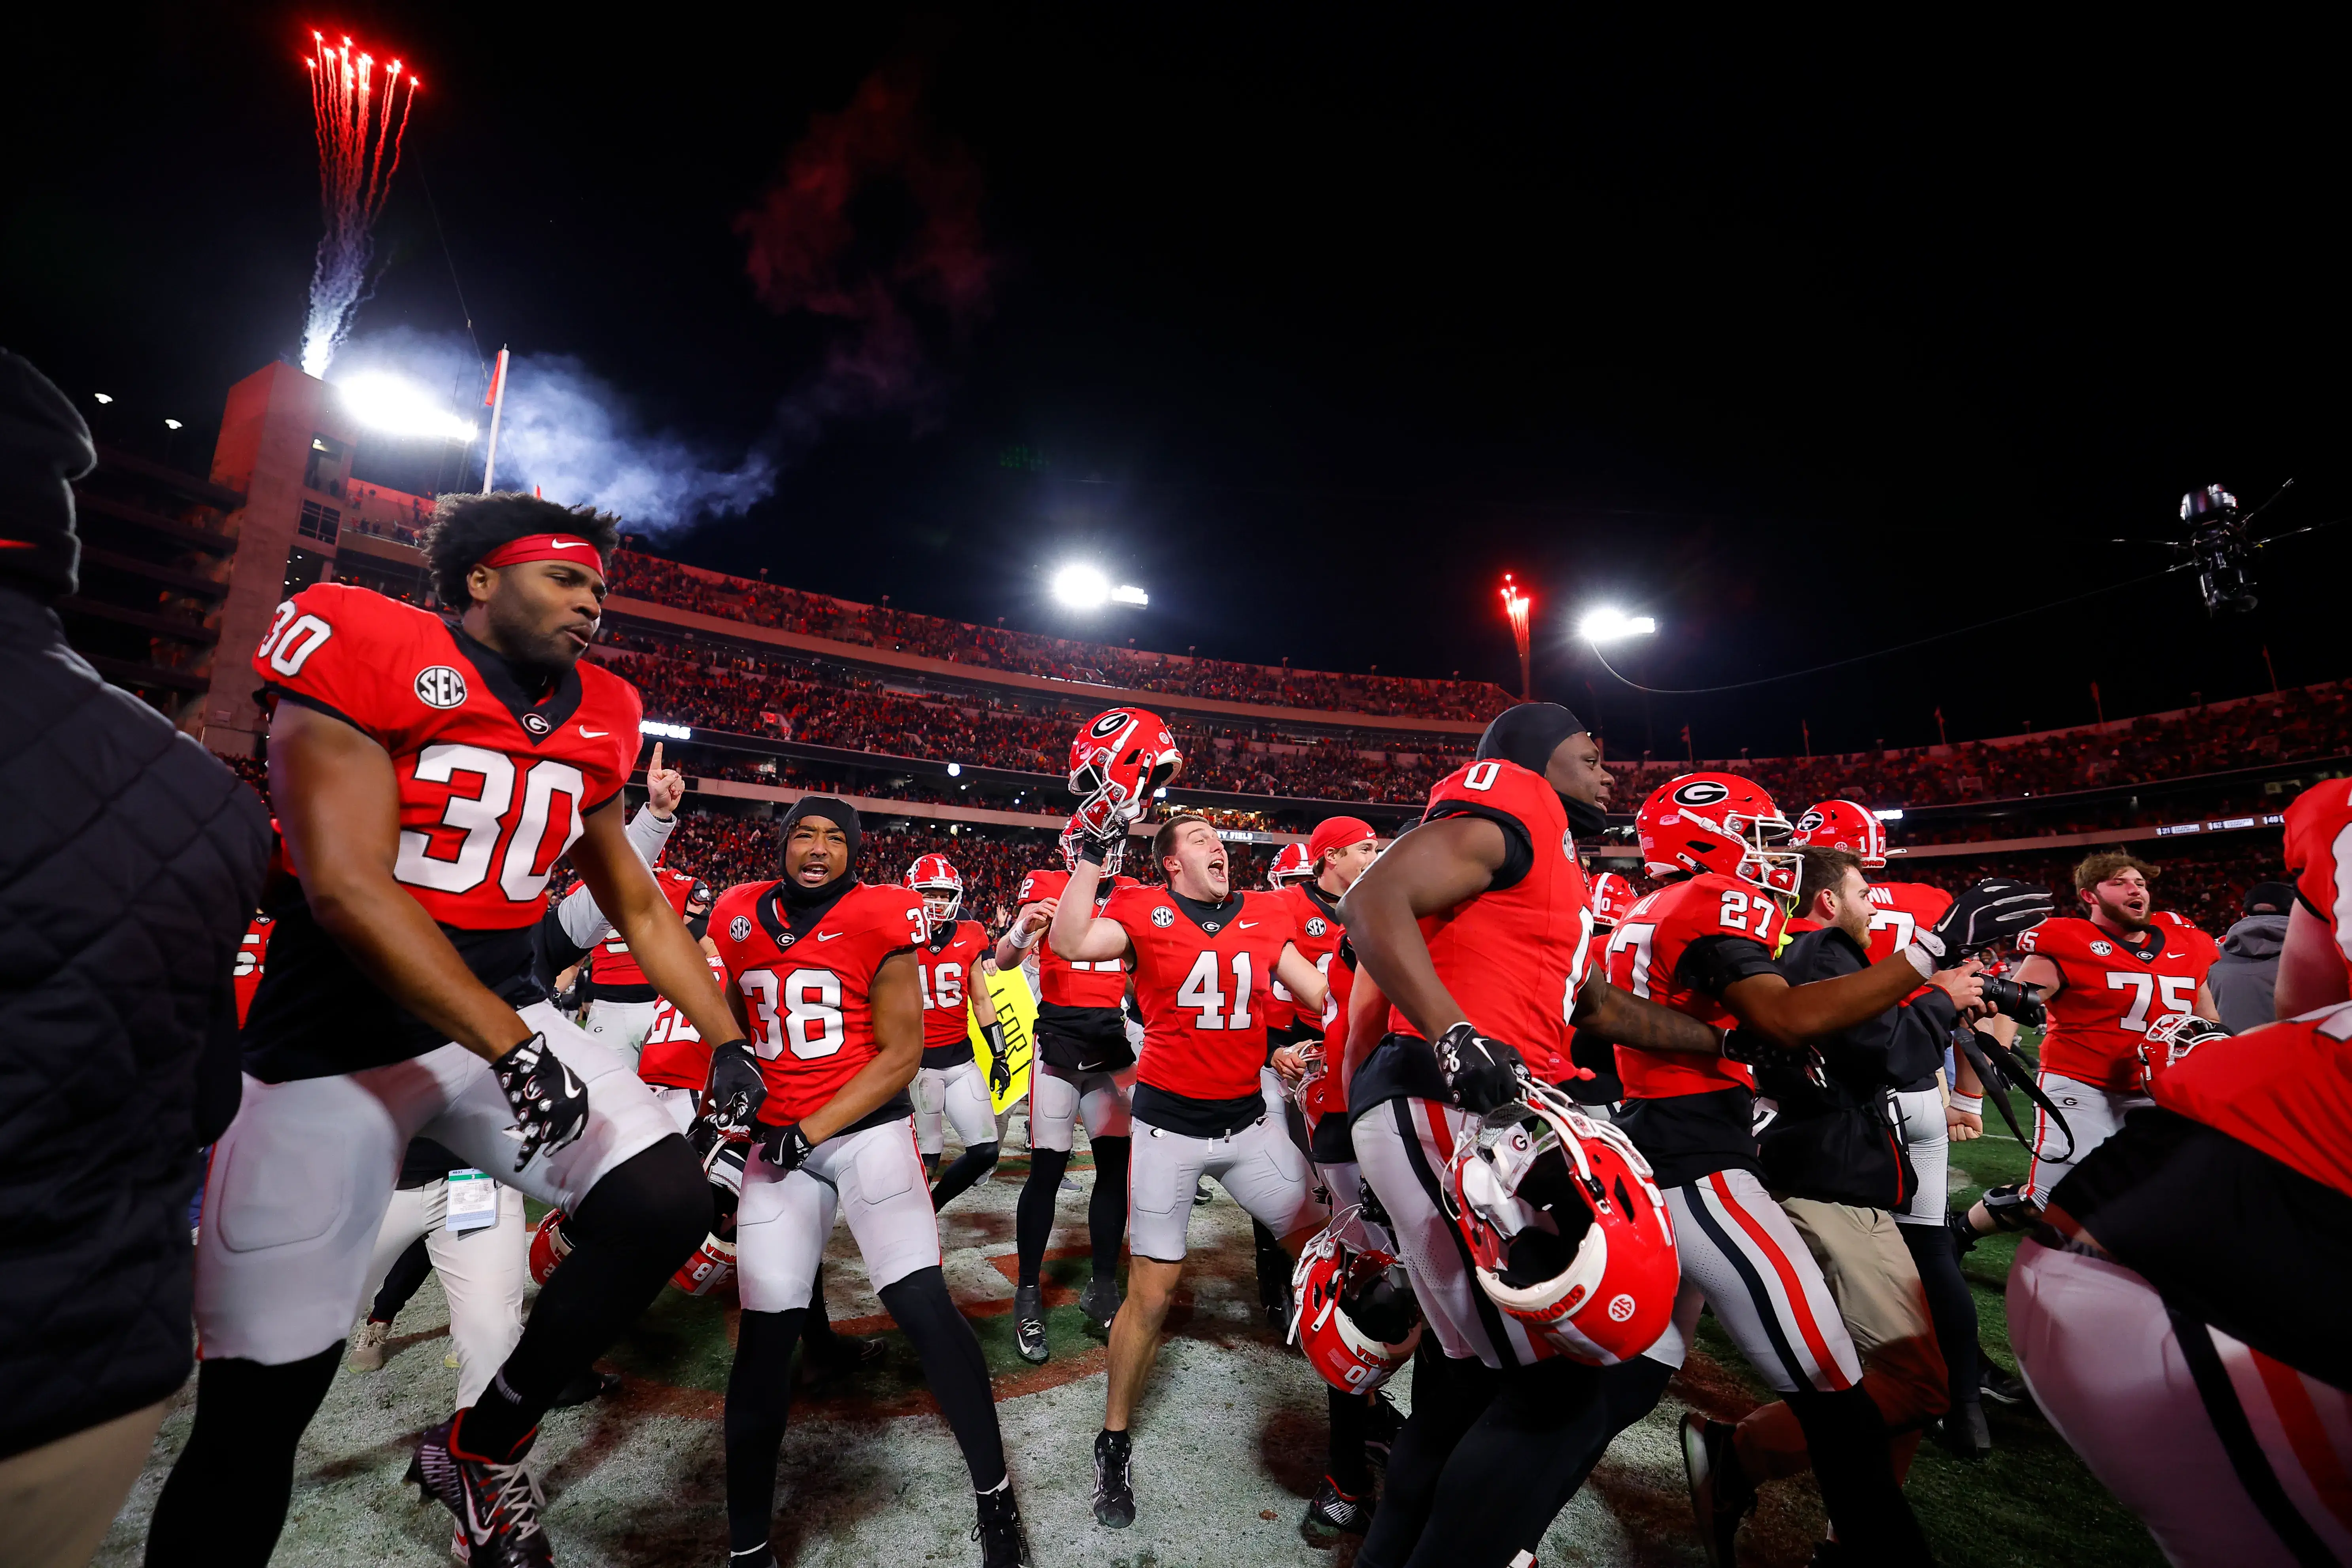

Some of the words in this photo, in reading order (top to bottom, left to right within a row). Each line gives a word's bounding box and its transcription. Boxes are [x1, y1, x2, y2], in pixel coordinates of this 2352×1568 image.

[257, 599, 332, 677] 30
[418, 668, 465, 707] SEC
[1090, 712, 1130, 739] G
[1463, 761, 1502, 791] 0
[1673, 781, 1729, 806] G
[394, 742, 586, 903] 30
[1796, 811, 1824, 832] G
[1230, 832, 1253, 840] FIELD
[1152, 907, 1173, 927] SEC
[1306, 918, 1325, 936] SEC
[1719, 890, 1775, 940] 27
[731, 917, 751, 941] SEC
[2090, 941, 2111, 955] SEC
[918, 962, 963, 1009] 16
[1177, 950, 1252, 1030] 41
[739, 968, 846, 1062] 38
[2106, 971, 2197, 1033] 75
[1511, 1134, 1530, 1152] G
[1611, 1297, 1633, 1319] SEC
